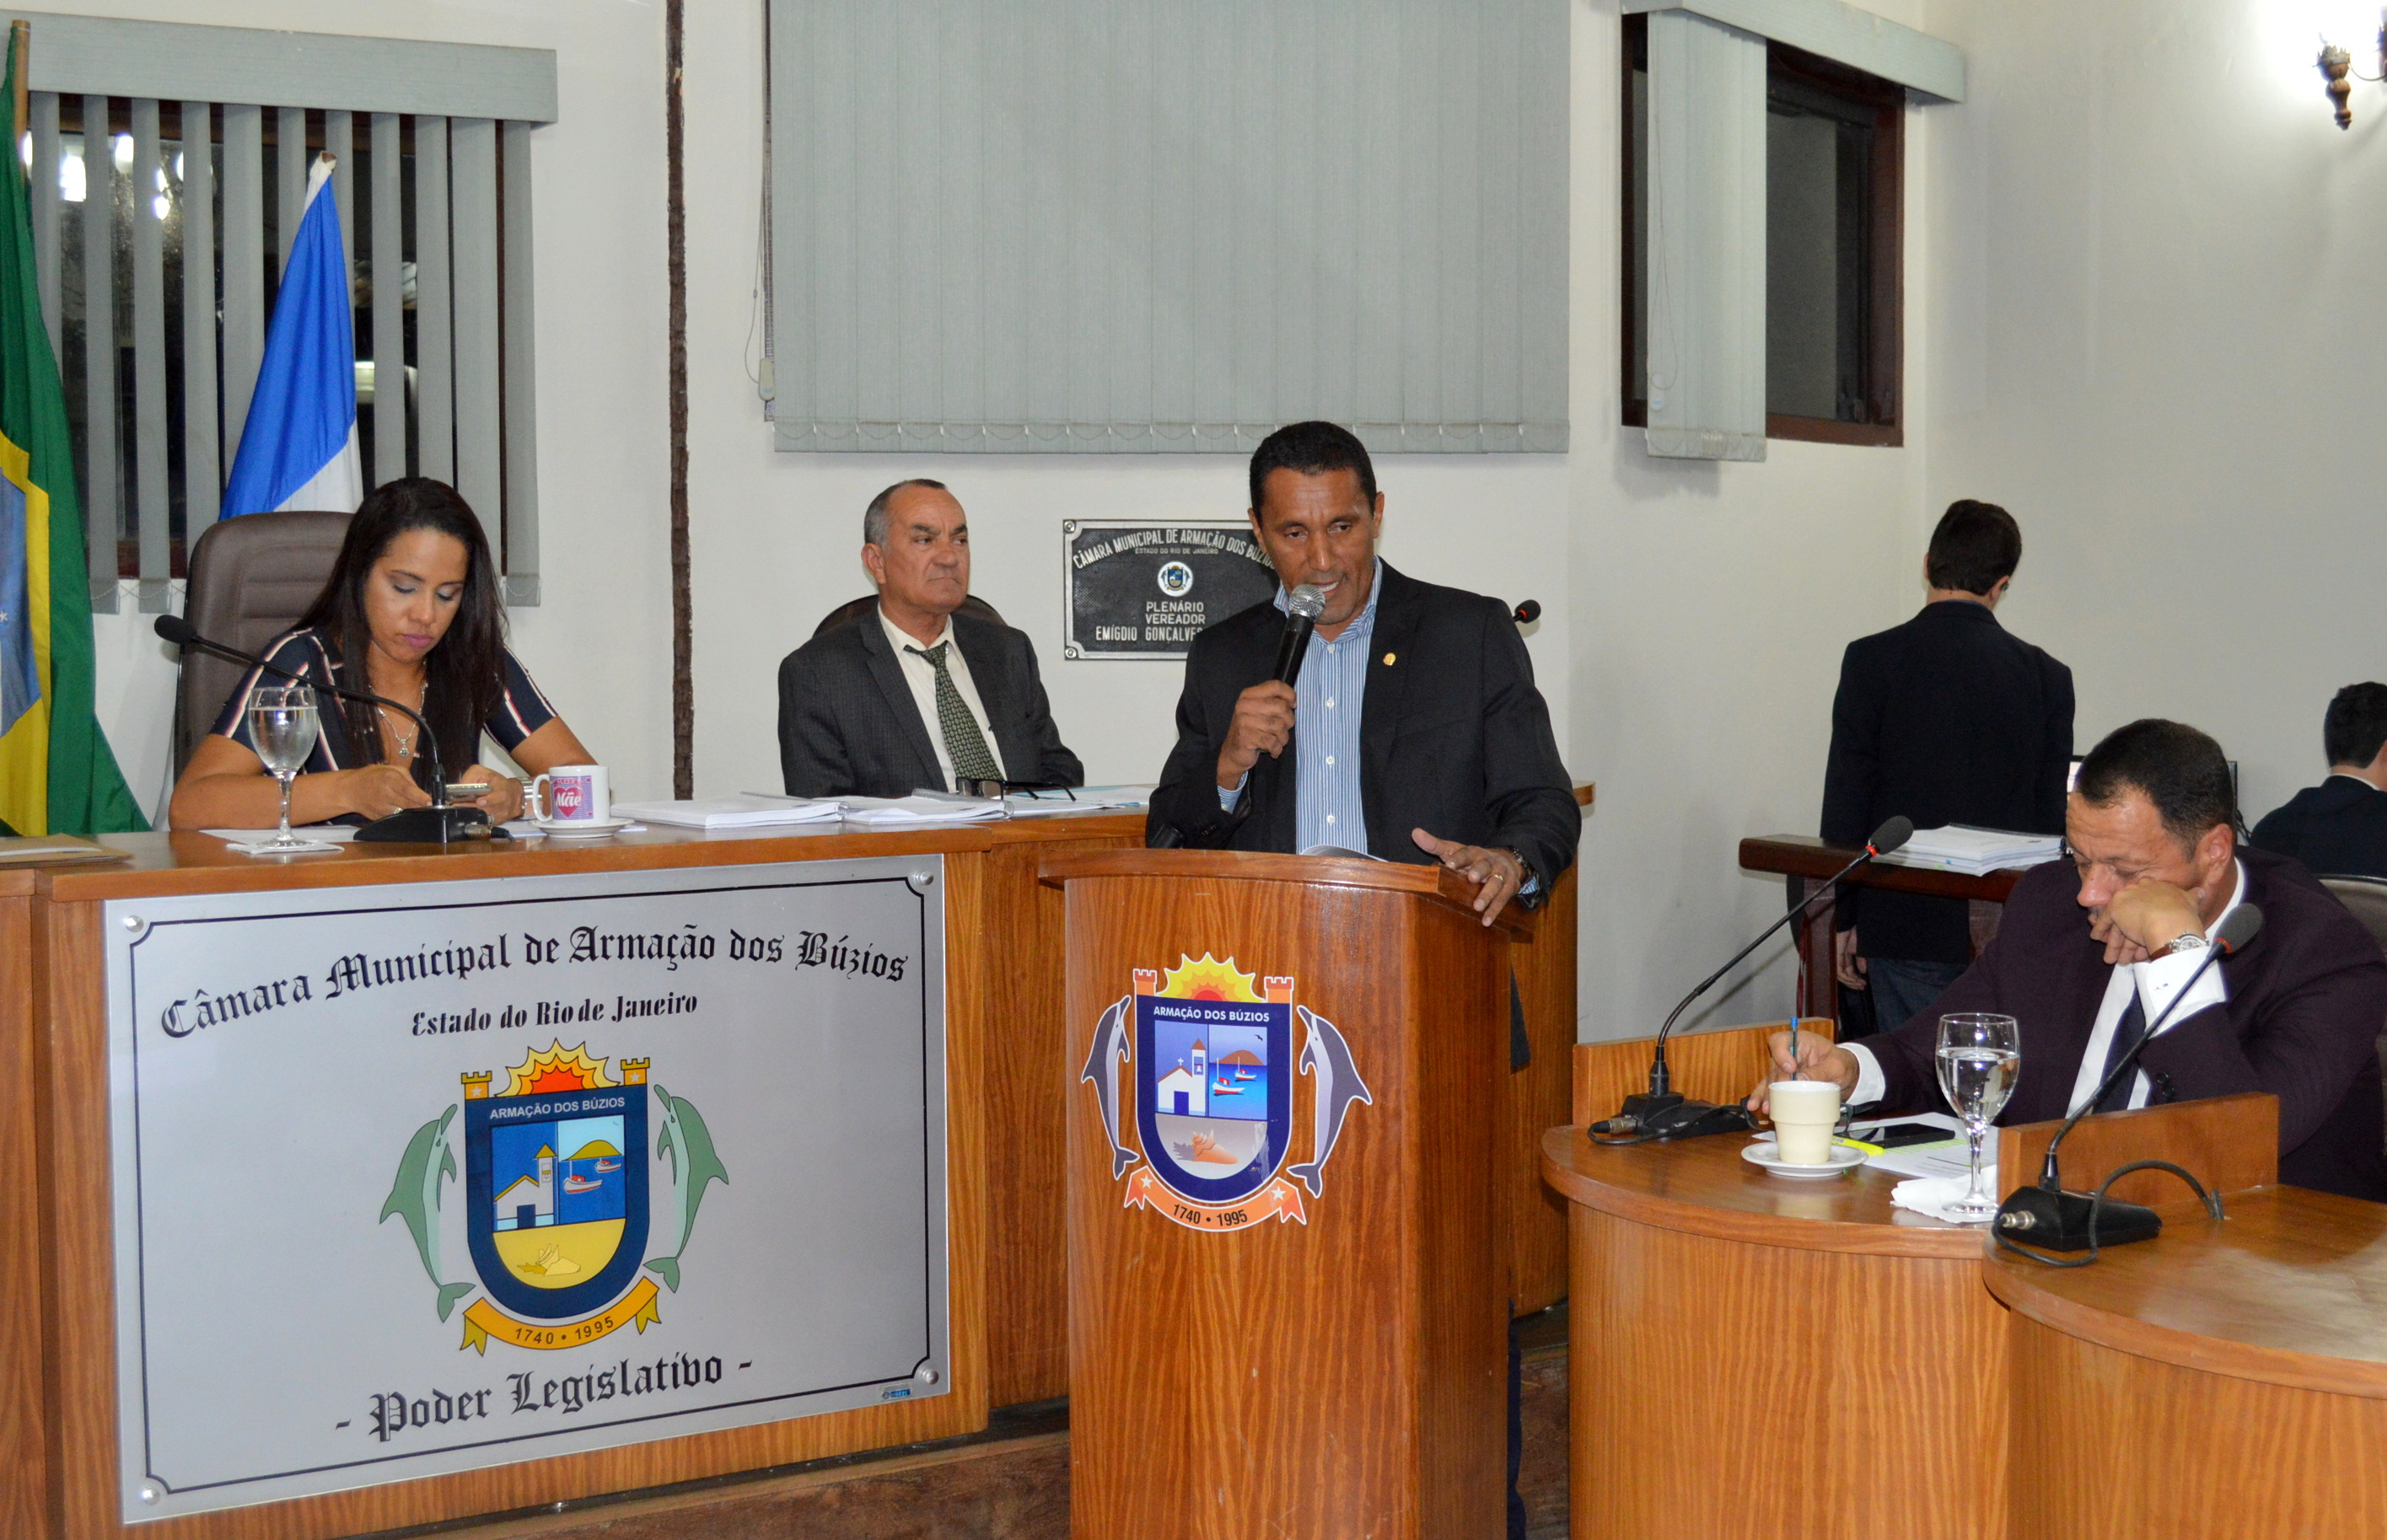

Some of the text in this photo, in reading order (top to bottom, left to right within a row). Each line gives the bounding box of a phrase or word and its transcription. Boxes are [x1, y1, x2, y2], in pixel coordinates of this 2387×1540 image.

[1073, 542, 1112, 569] CÂMARA
[1114, 529, 1164, 553] MUNICIPAL
[1166, 529, 1178, 544] DE
[1180, 529, 1225, 550] ARMAÇÃO
[1226, 537, 1246, 555] DOS
[1146, 599, 1204, 613] PLENÁRIO
[1145, 614, 1206, 625] VEREADOR
[1096, 625, 1137, 641] EMÍGDIO
[556, 791, 582, 807] Mãe
[161, 924, 910, 1038] Câmara Municipal de Armação dos Búzios
[411, 991, 698, 1038] Estado do Rio de Janeiro
[1153, 1006, 1270, 1022] ARMAÇÃO DOS BÚZIOS
[490, 1097, 626, 1119] ARMAÇÃO DOS BÚZIOS
[1173, 1204, 1248, 1226] 1740 1995
[515, 1316, 615, 1344] 1740 1995
[368, 1387, 492, 1443] Poder
[506, 1352, 723, 1414] Legislativo
